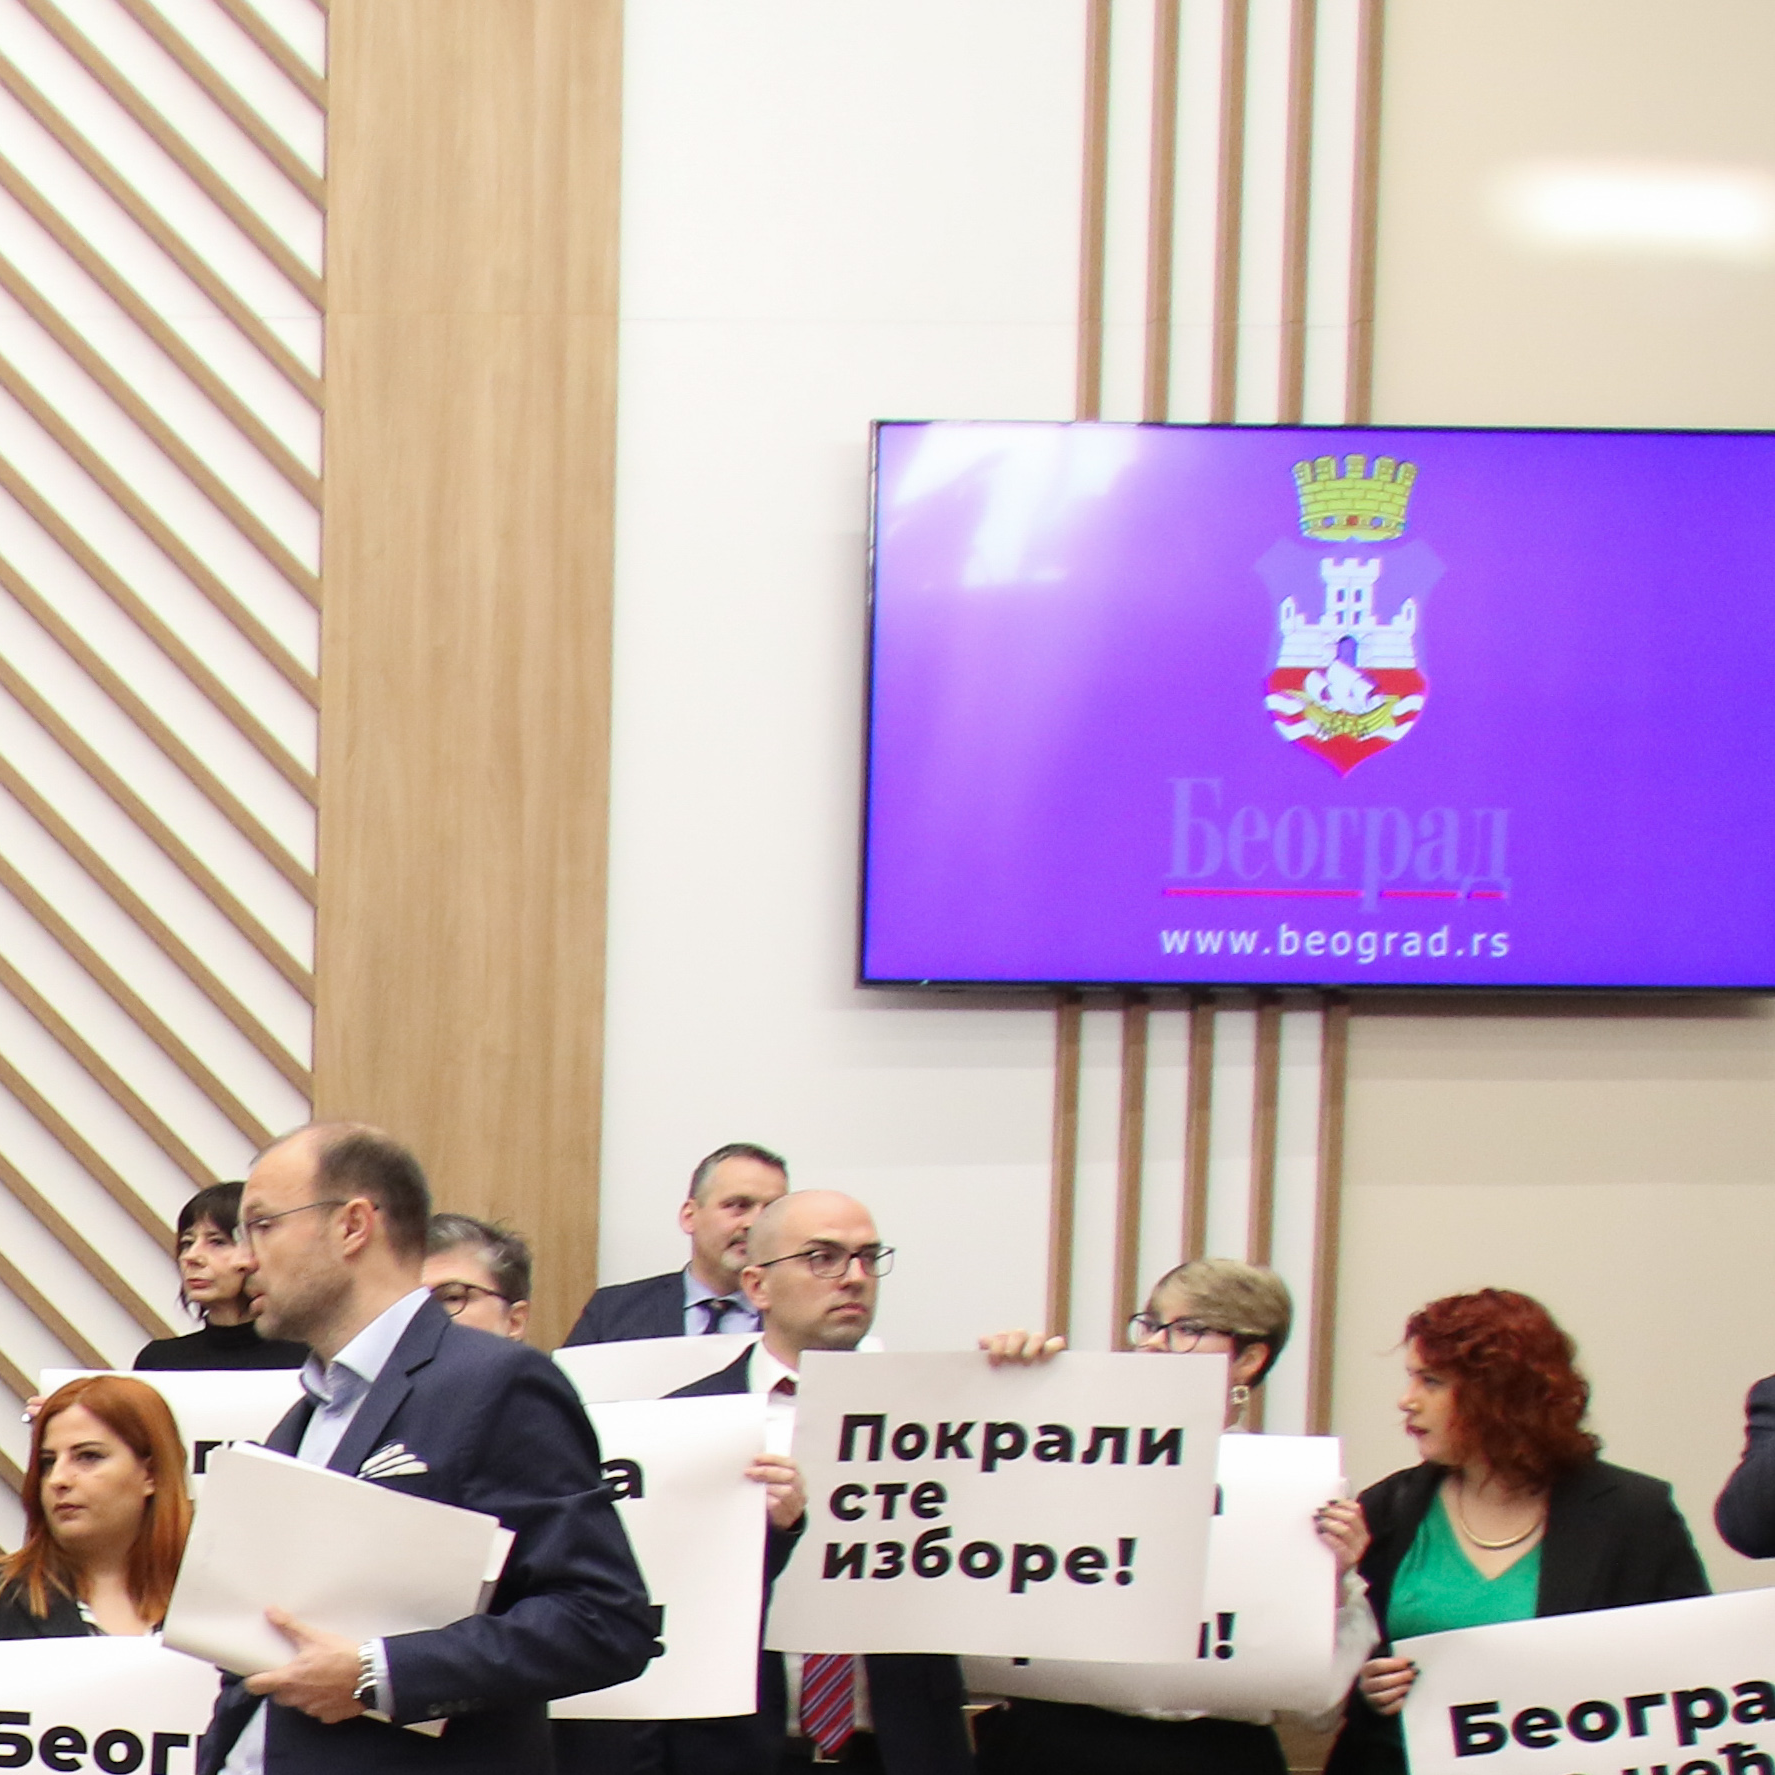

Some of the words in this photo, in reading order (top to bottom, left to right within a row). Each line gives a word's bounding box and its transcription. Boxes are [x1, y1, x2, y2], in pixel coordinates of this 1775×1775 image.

[1164, 777, 1513, 912] Београд
[1159, 924, 1511, 965] www.beograd.rs
[838, 1414, 1182, 1472] Покрали
[830, 1482, 946, 1521] сте
[823, 1527, 1135, 1593] изборе!
[1449, 1681, 1775, 1757] Београ
